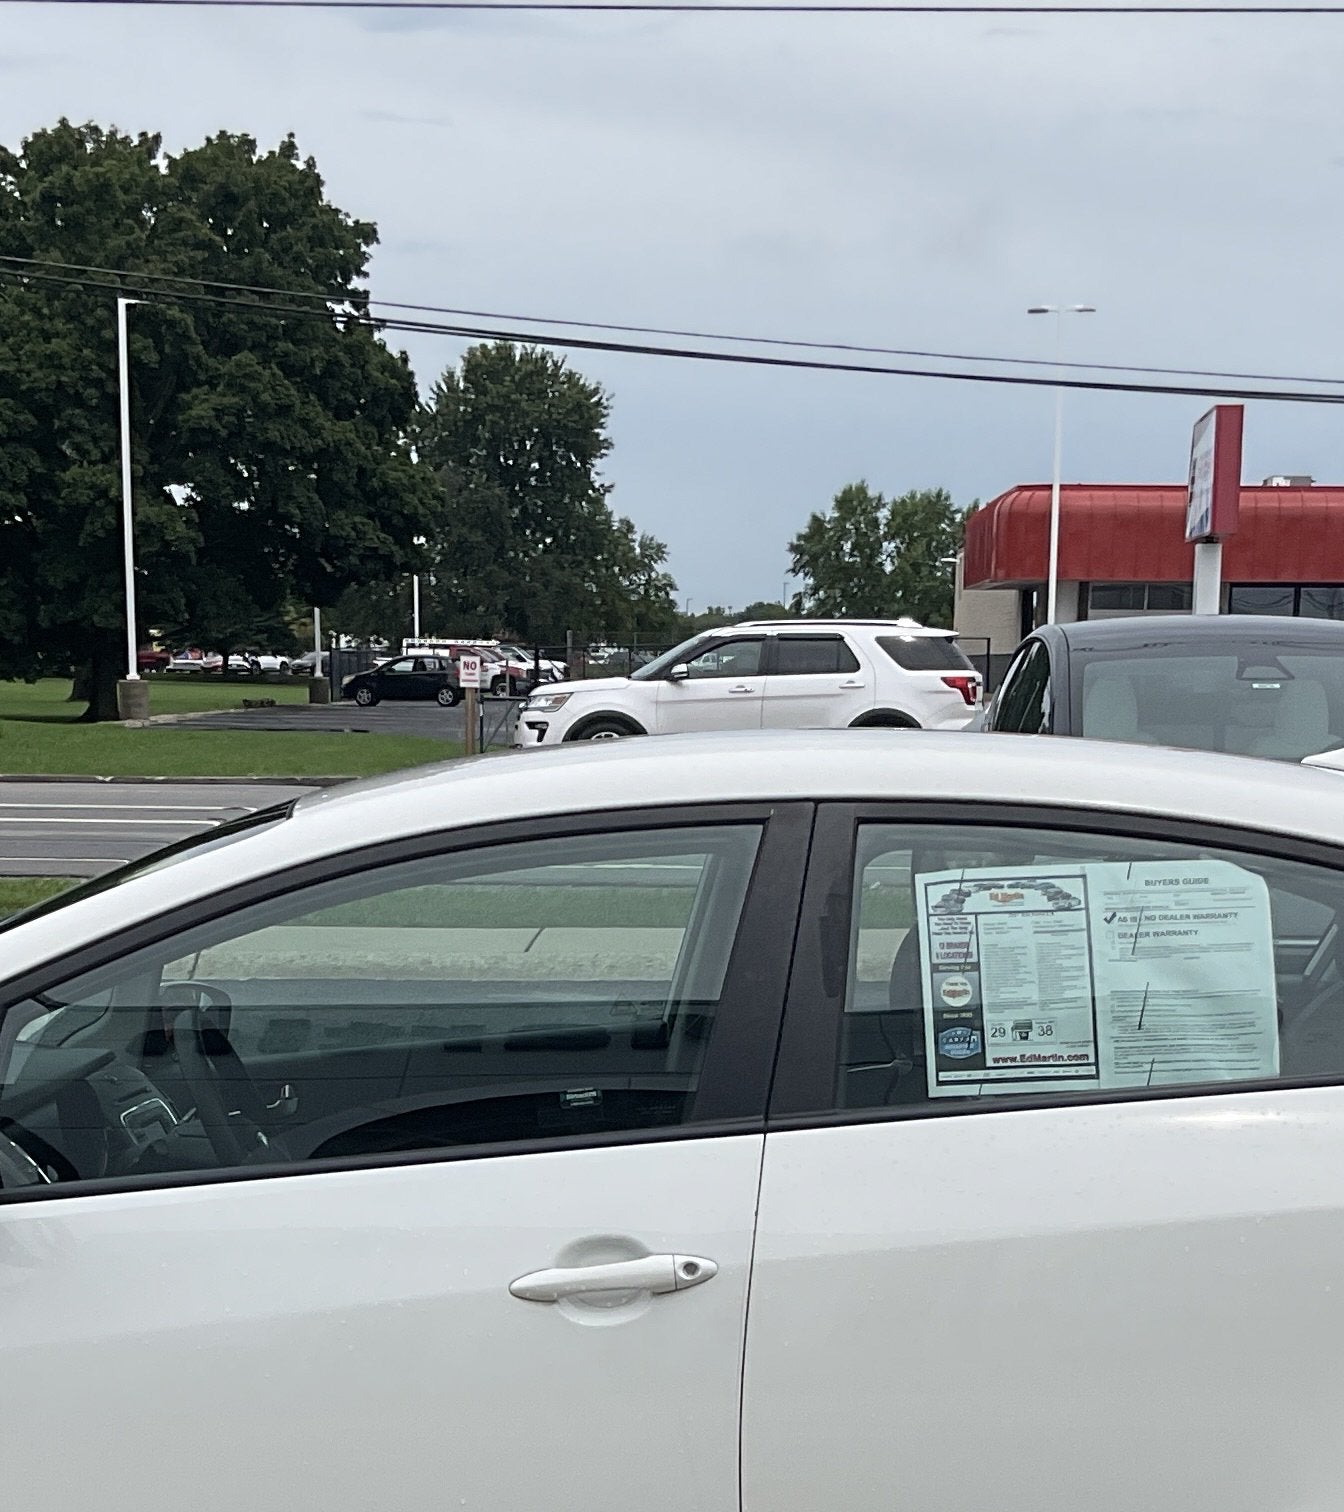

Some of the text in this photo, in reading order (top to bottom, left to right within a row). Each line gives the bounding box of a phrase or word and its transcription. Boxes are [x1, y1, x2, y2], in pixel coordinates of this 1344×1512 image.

[463, 661, 477, 670] NO
[1144, 879, 1180, 887] BUYERS
[1152, 929, 1199, 937] WARRANTY
[990, 1026, 1007, 1038] 29
[1037, 1024, 1054, 1037] 38
[992, 1052, 1089, 1065] www.EdMartin.com
